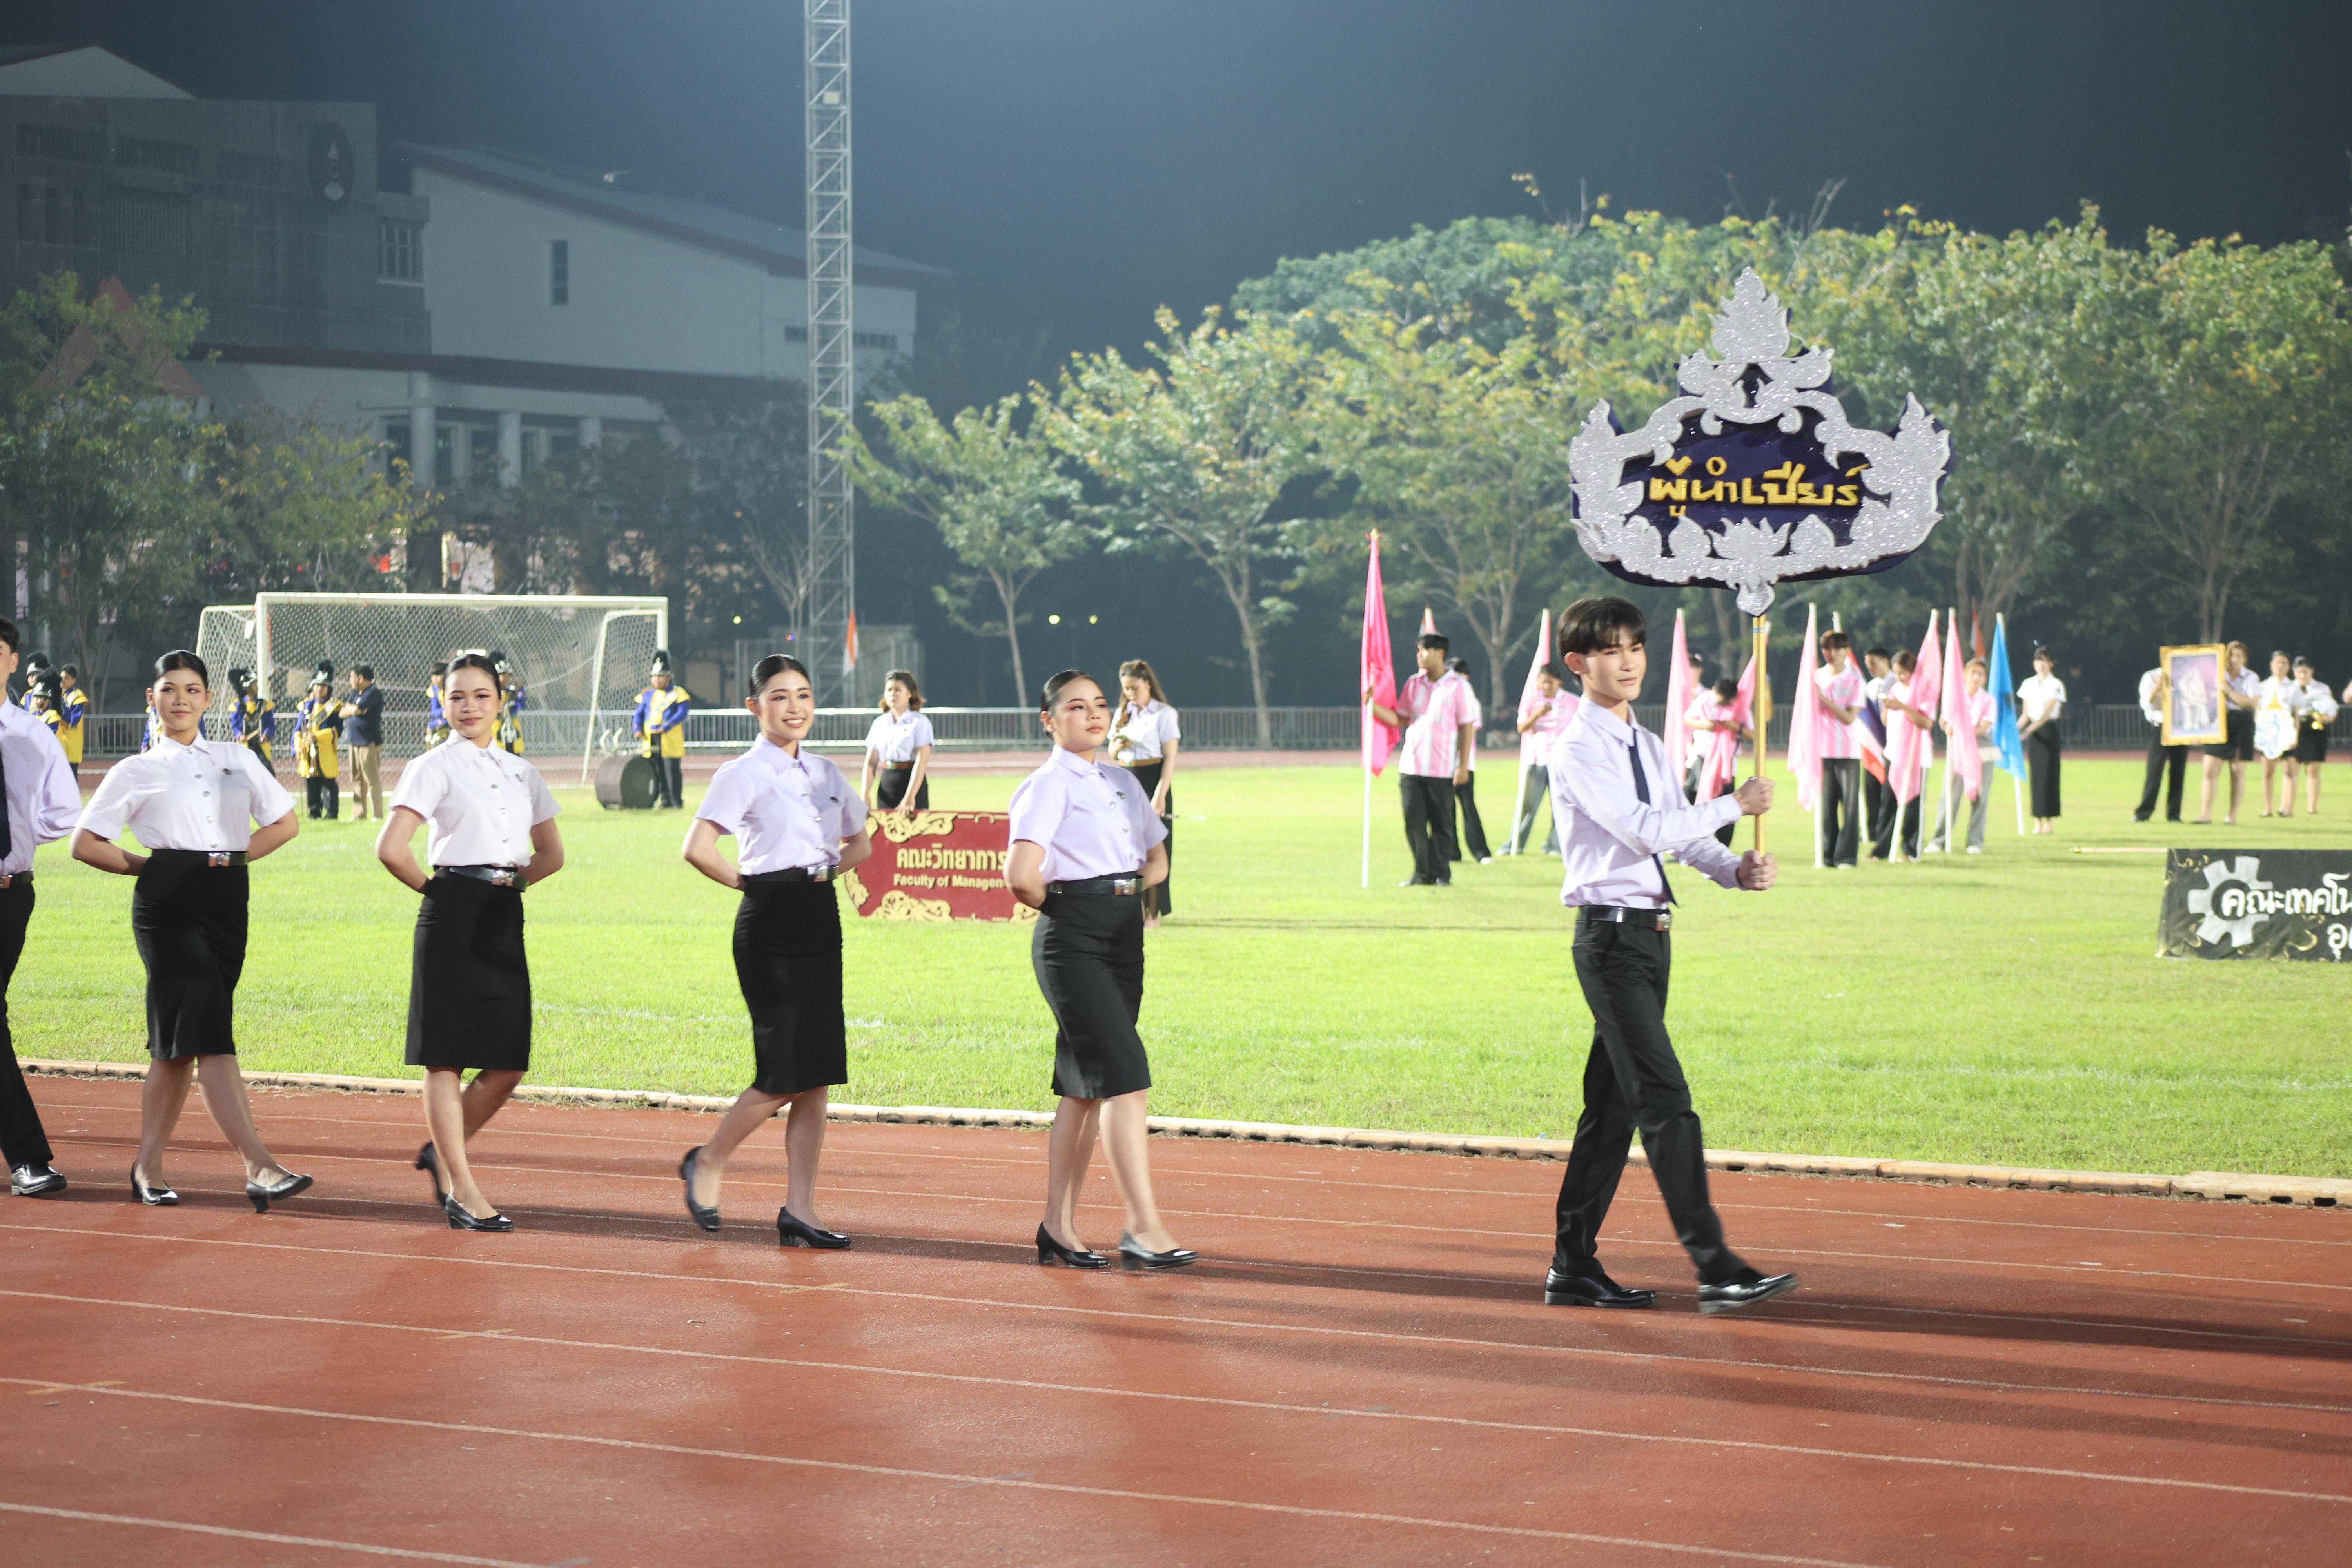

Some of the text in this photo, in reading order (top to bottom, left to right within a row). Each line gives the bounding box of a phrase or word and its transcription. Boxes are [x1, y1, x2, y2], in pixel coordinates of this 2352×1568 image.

[893, 873, 935, 889] Faculty
[937, 876, 949, 887] of
[2221, 873, 2352, 917] คณะเทคโน
